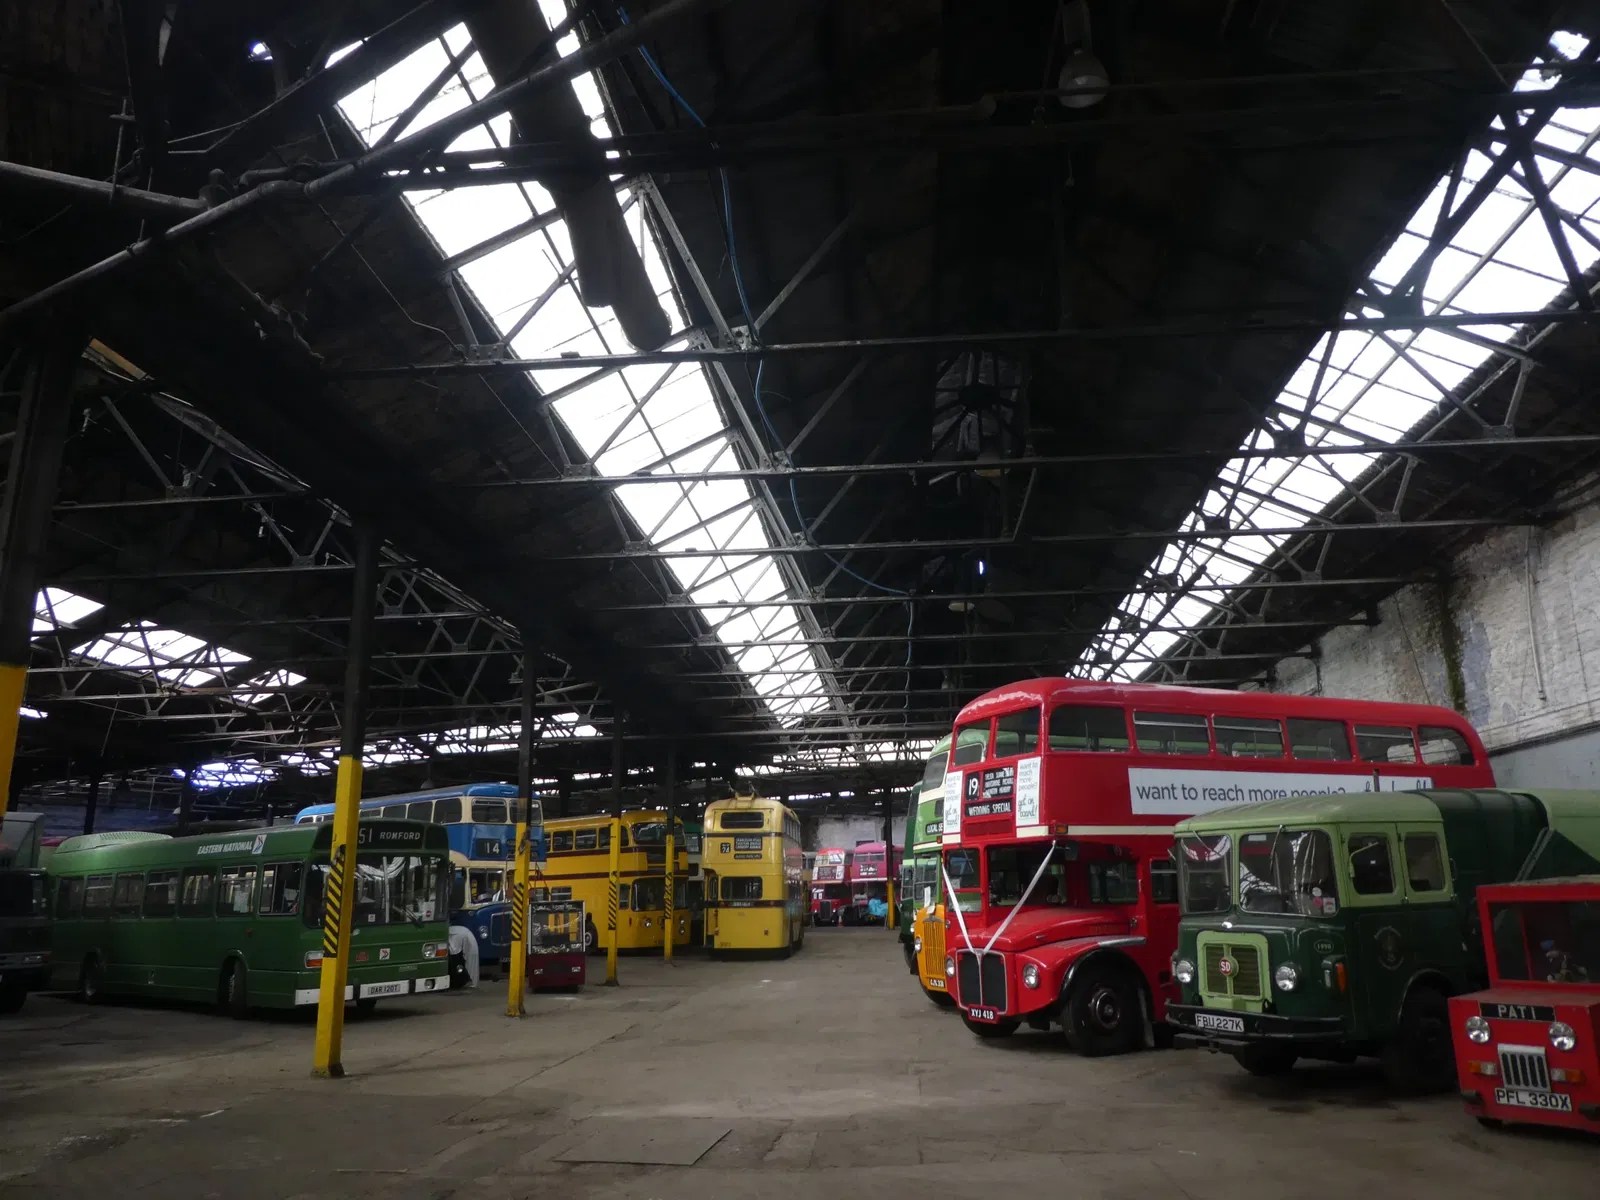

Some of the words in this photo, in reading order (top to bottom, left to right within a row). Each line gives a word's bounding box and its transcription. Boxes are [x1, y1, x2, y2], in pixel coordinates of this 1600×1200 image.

[969, 777, 979, 796] 19
[1136, 783, 1178, 801] want
[1182, 783, 1198, 801] to
[1202, 784, 1244, 801] reach
[1248, 787, 1287, 802] more
[968, 805, 990, 816] WEDDING
[992, 802, 1012, 814] SPECIAL
[380, 831, 421, 841] ROMFORD
[197, 843, 223, 855] EASTERN
[223, 840, 253, 853] NATIONAL
[486, 842, 500, 855] 14
[1220, 962, 1231, 972] SD
[971, 1008, 981, 1018] XYJ
[983, 1010, 993, 1020] 418
[1196, 1015, 1215, 1028] FBU
[1216, 1018, 1243, 1031] 227K
[1497, 1090, 1525, 1105] PFL
[1529, 1092, 1569, 1109] 330X
